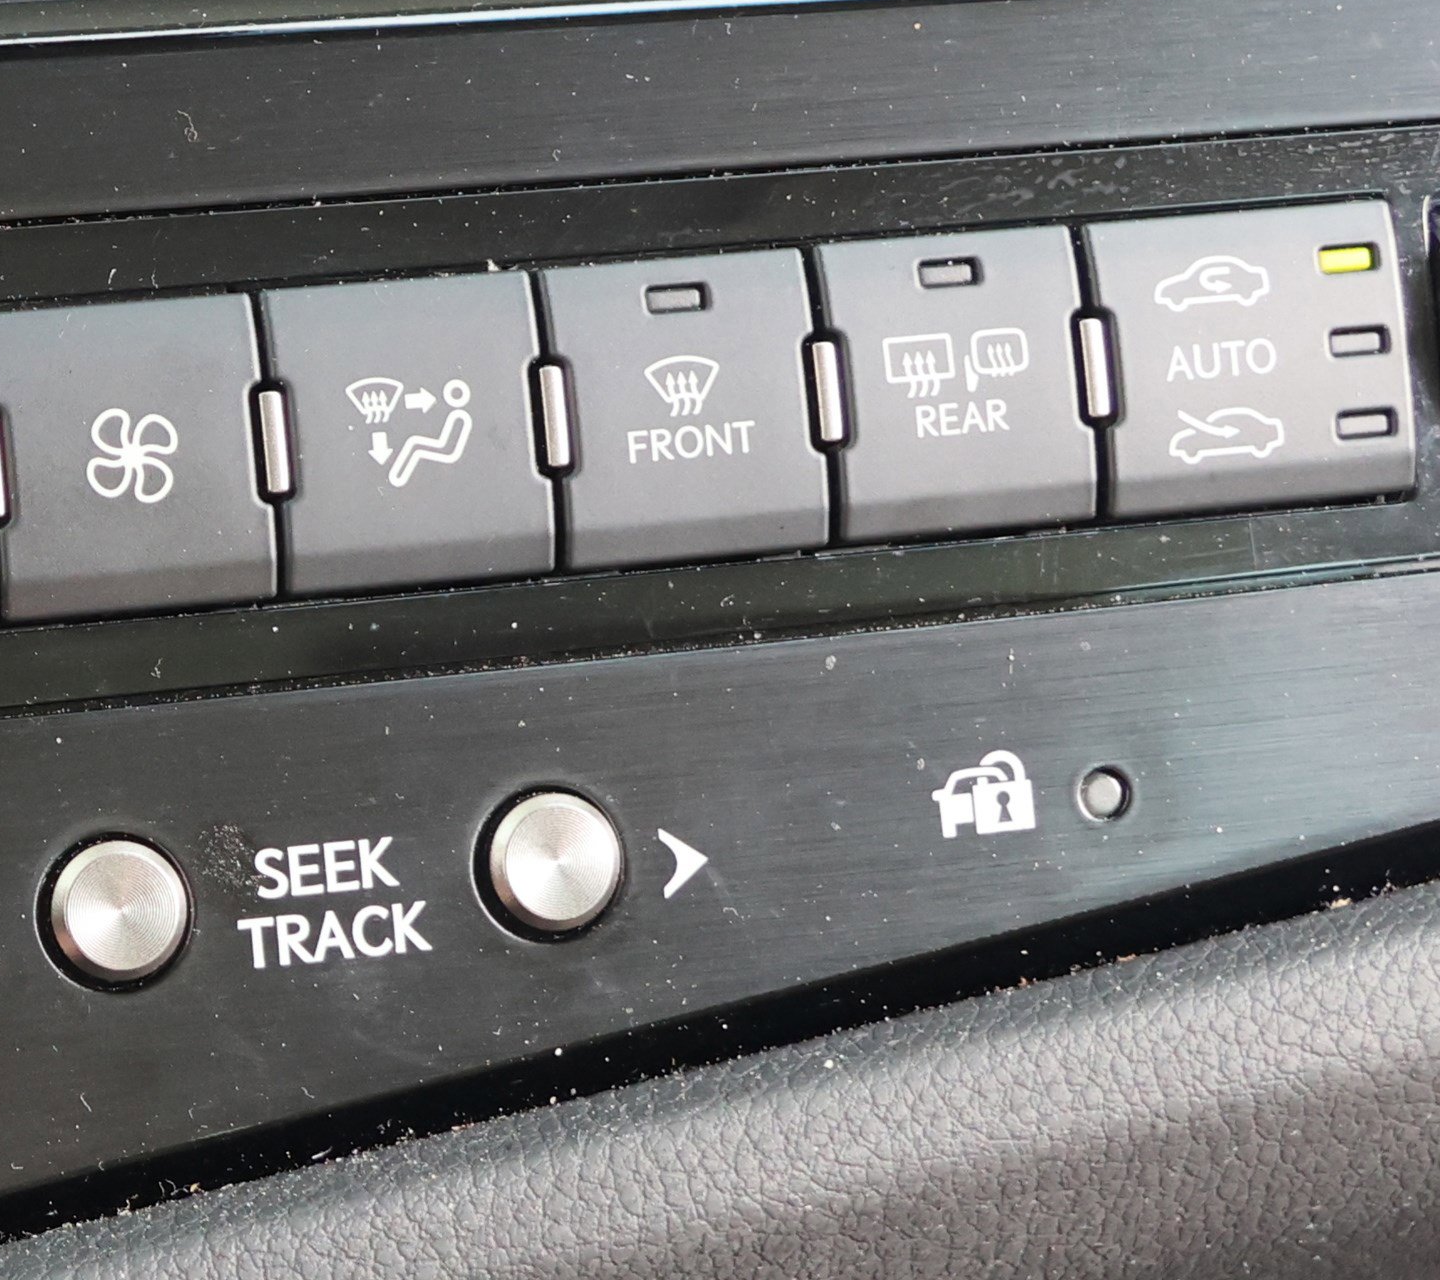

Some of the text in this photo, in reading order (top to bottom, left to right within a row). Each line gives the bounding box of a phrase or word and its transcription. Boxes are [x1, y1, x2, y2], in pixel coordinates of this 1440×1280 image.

[1166, 337, 1277, 382] AUTO
[915, 399, 1010, 438] REAR
[627, 420, 755, 464] FRONT
[254, 836, 400, 899] SEEK
[237, 900, 433, 969] TRACK
